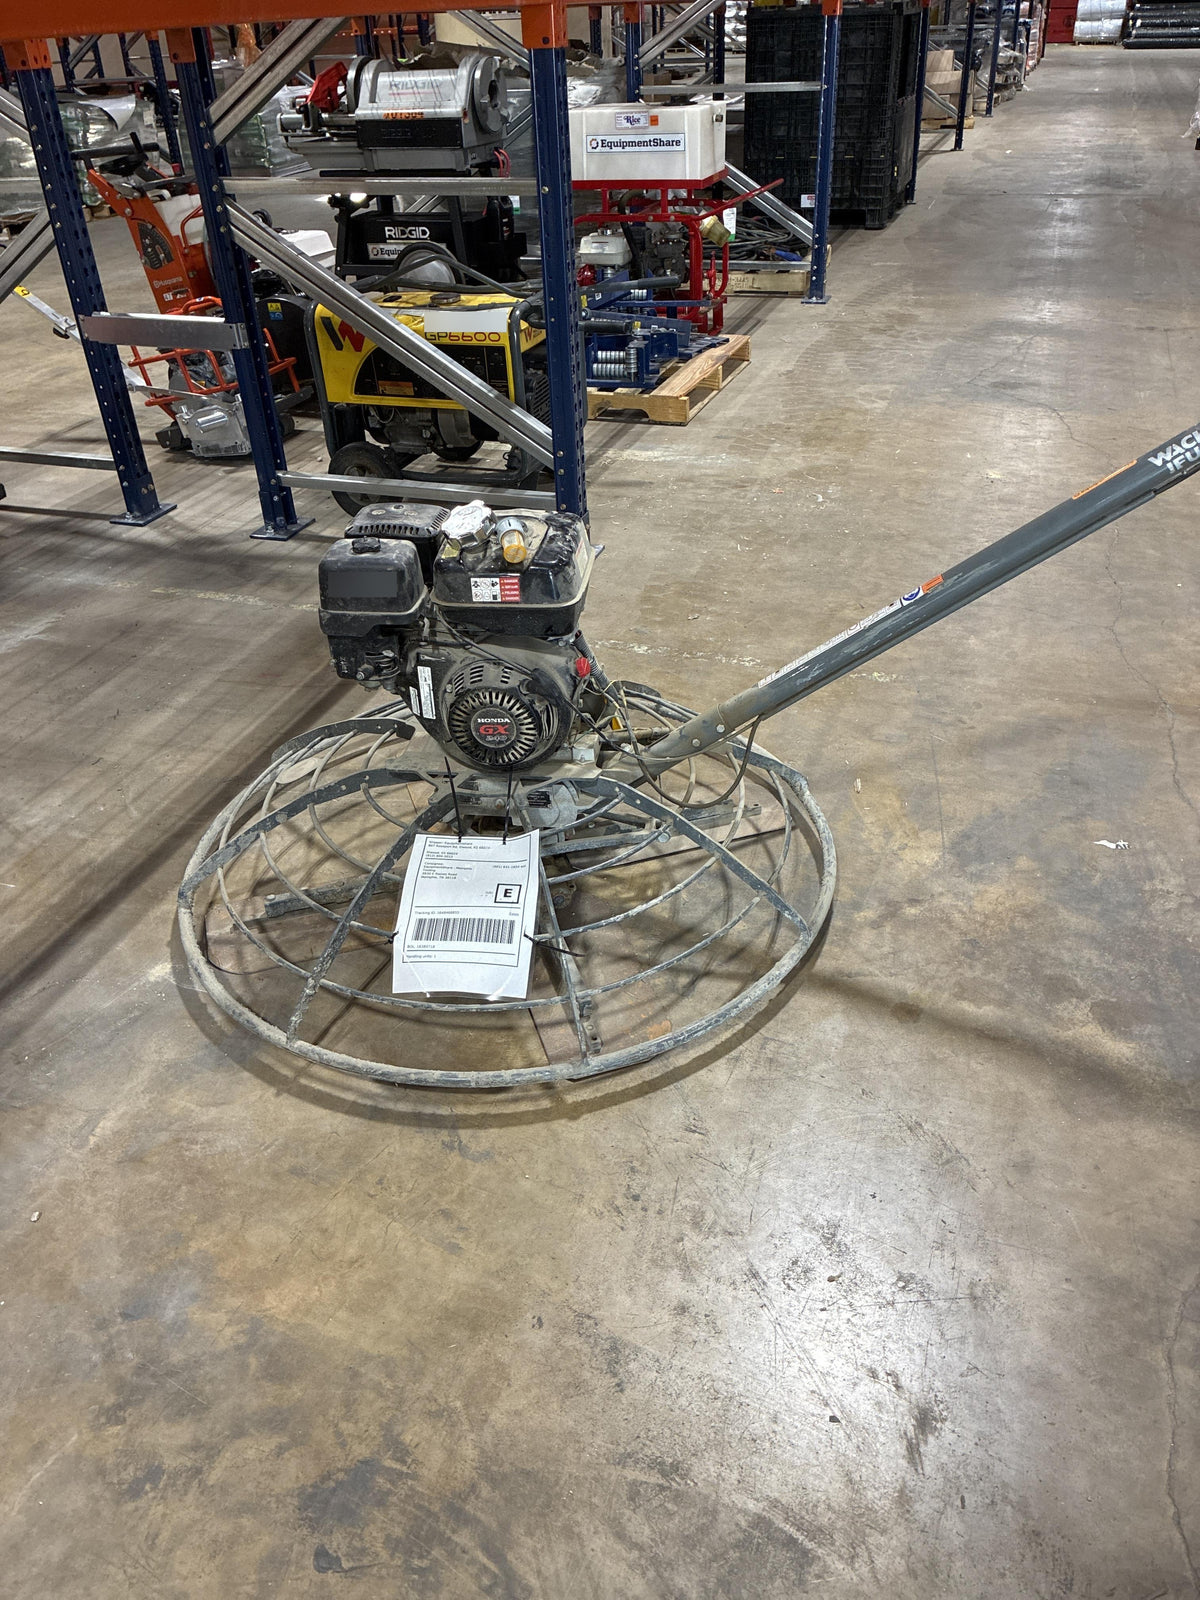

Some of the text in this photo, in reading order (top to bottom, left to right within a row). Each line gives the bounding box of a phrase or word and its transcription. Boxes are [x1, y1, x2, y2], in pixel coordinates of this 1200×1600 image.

[600, 138, 681, 149] EquipmentShare
[384, 226, 430, 239] RIDGID
[424, 331, 501, 342] GP6600
[479, 724, 510, 735] GX
[503, 888, 513, 898] E
